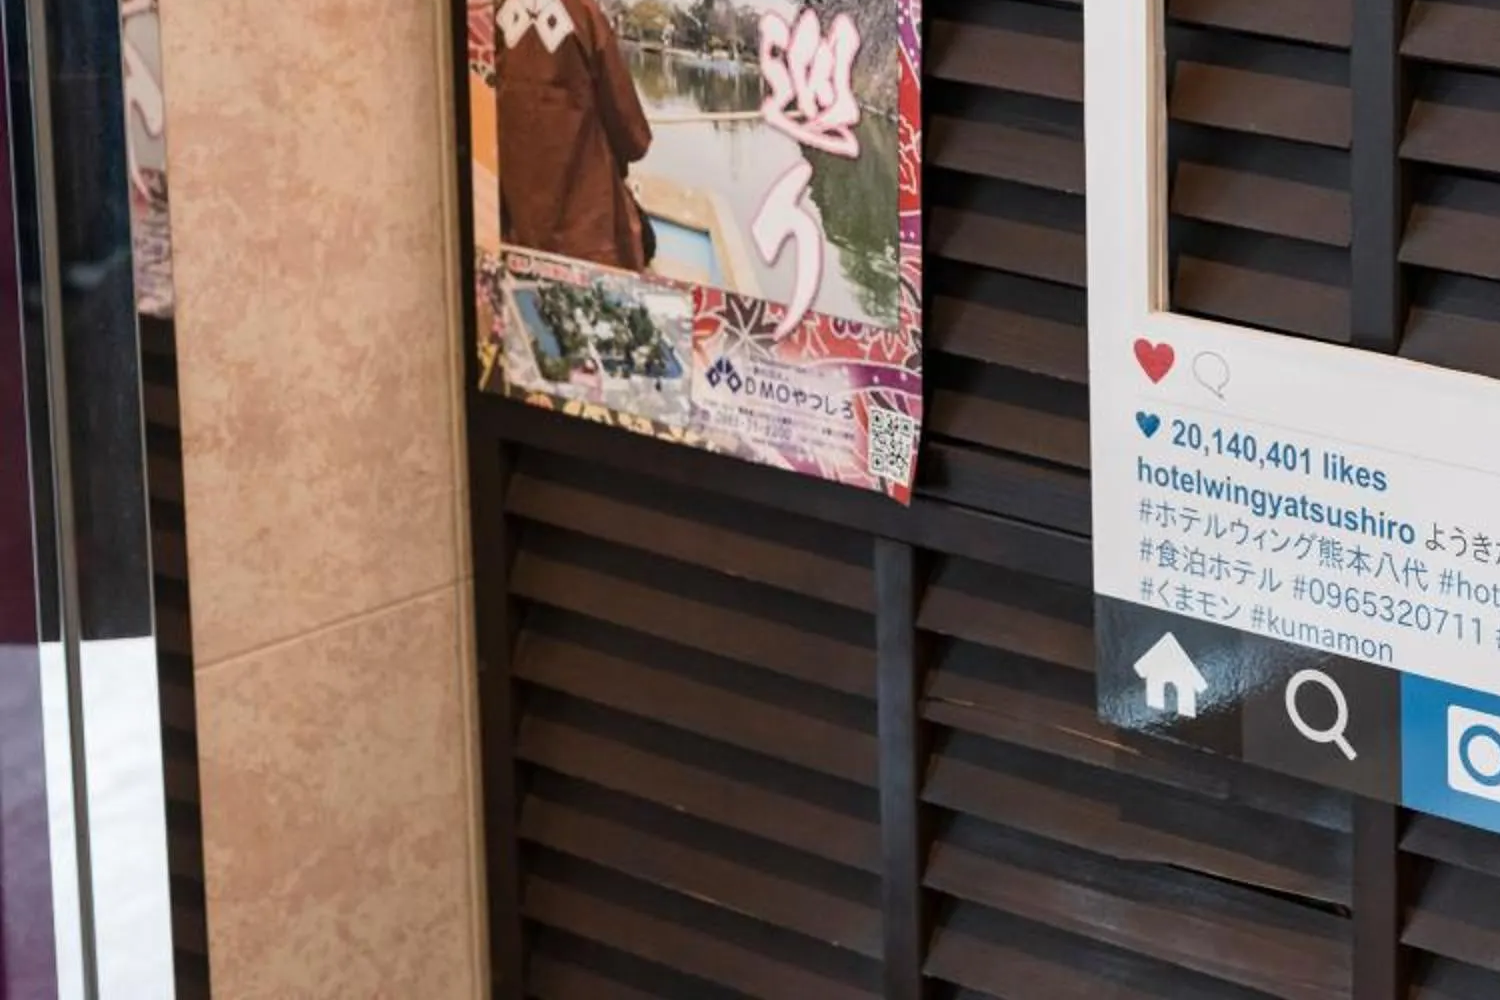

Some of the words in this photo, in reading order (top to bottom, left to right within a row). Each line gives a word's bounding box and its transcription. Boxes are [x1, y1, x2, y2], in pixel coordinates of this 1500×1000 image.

[1171, 418, 1312, 475] 20,140,401
[1322, 452, 1389, 492] likes
[1137, 456, 1417, 545] hotelwingyatsushiro
[1138, 498, 1430, 594] #ホテルウィング熊本八代
[1139, 536, 1283, 594] #食泊ホテル
[1292, 573, 1484, 646] #0965320711
[1139, 576, 1243, 624] #くまモン
[1251, 603, 1395, 663] #kumamon
